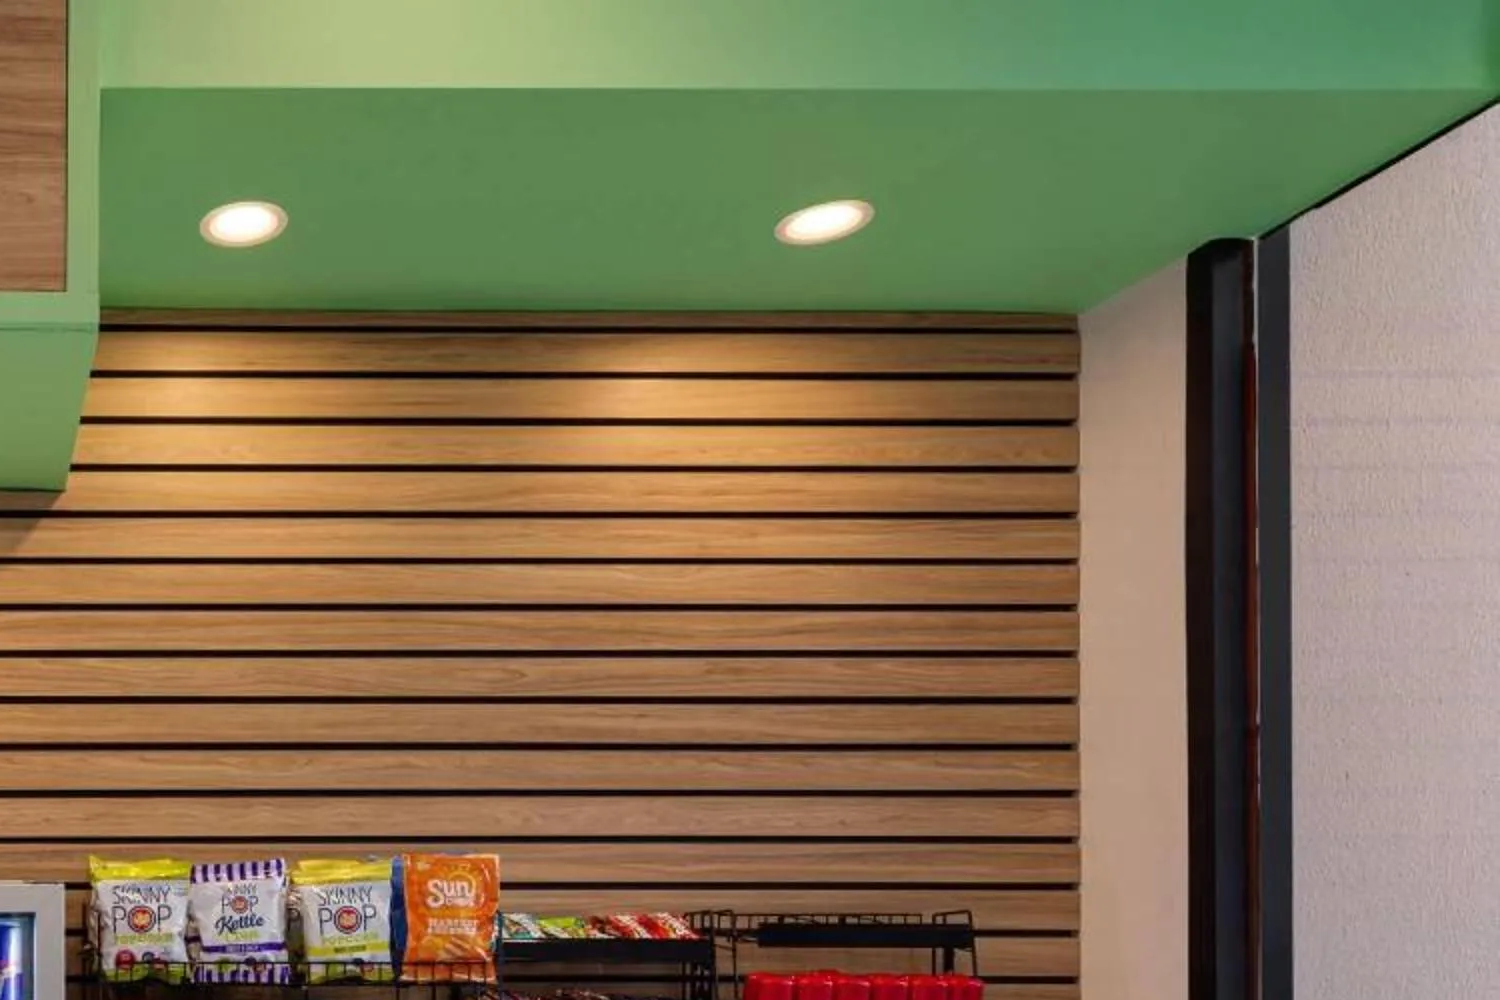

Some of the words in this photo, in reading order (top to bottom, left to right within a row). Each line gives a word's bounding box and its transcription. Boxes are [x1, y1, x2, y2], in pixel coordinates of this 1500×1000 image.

[221, 895, 259, 914] POP
[425, 879, 473, 908] Sun
[112, 904, 172, 934] POP
[215, 913, 264, 936] Kettle
[317, 903, 377, 936] POP
